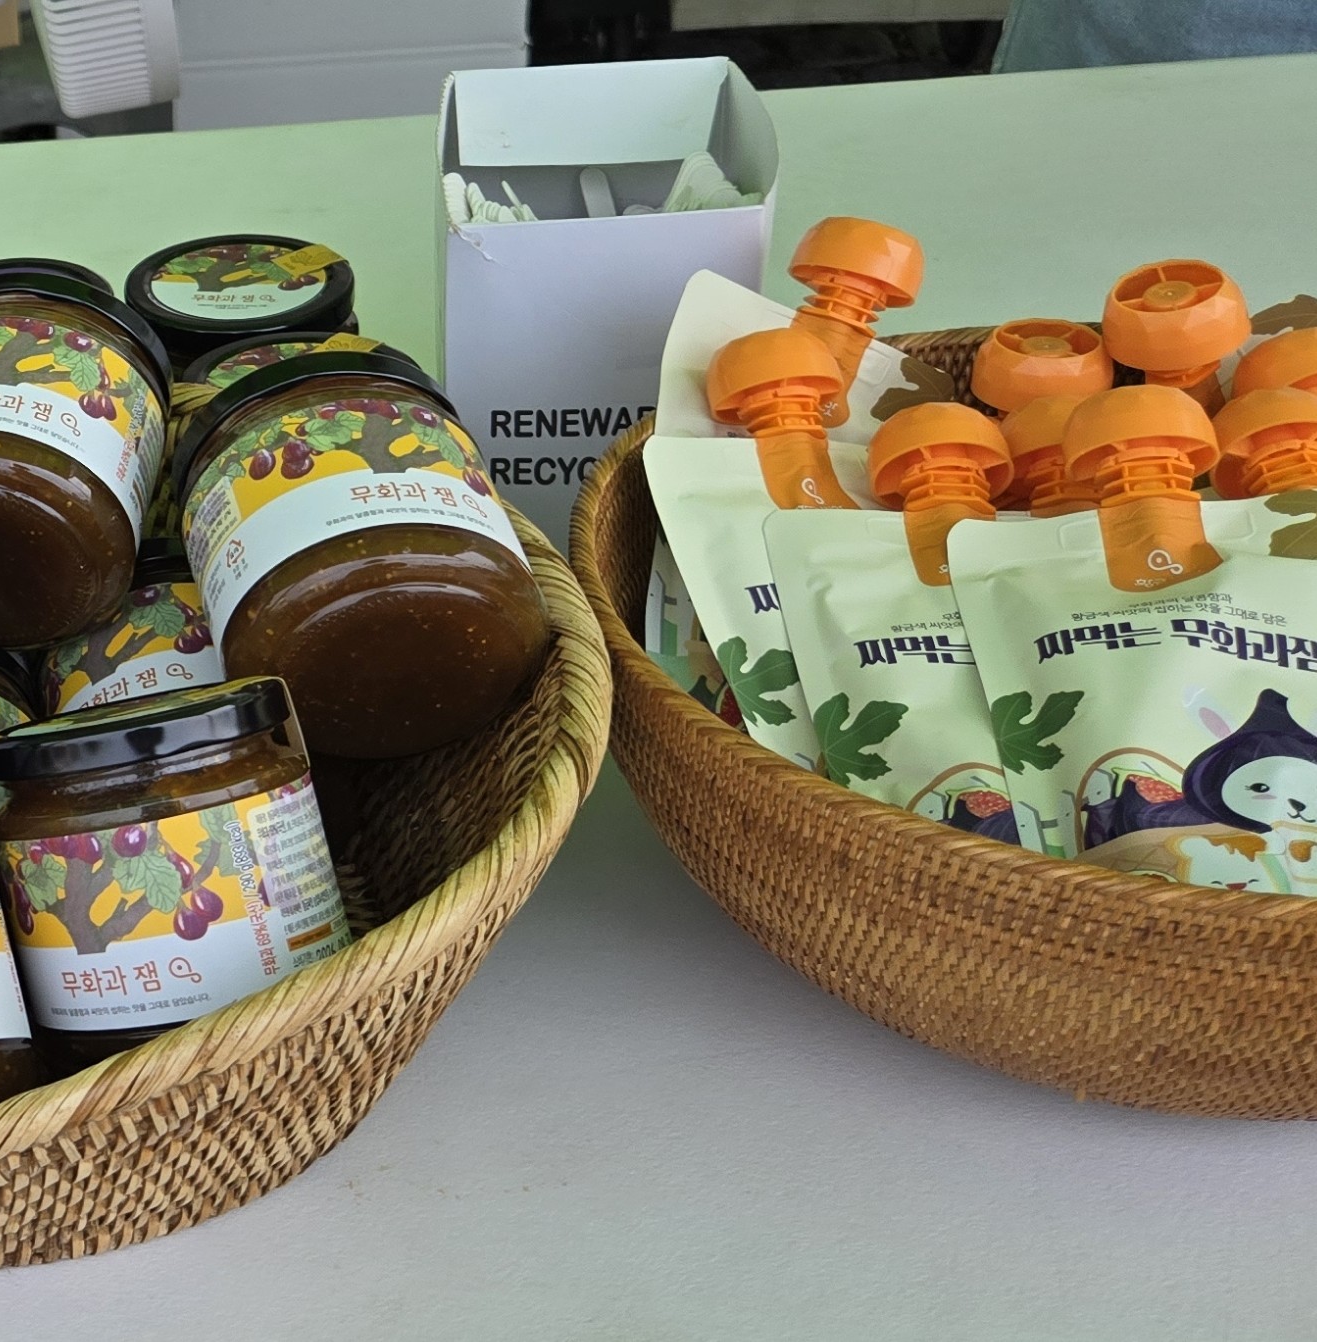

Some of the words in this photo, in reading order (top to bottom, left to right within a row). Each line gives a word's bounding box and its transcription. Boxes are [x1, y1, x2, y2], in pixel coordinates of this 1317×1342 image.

[31, 400, 54, 422] 잼
[491, 406, 656, 438] RENEWA
[350, 481, 427, 503] 무화과
[431, 485, 458, 507] 잼
[890, 621, 928, 633] 황금색
[1071, 610, 1110, 622] 황금색
[1113, 606, 1152, 618] 씨앗의
[1155, 604, 1193, 617] 씹히는
[1223, 606, 1259, 621] 그대로
[1261, 613, 1288, 627] 담은
[1034, 621, 1162, 665] 짜먹는
[80, 677, 129, 709] 화과
[135, 667, 157, 689] 잼
[223, 821, 242, 845] kcal)
[240, 873, 256, 893] 290
[259, 949, 280, 976] 무화과
[61, 965, 127, 998] 무화과
[133, 960, 161, 993] 잼
[132, 1003, 147, 1012] 맛을
[148, 999, 170, 1010] 그대로
[171, 992, 212, 1008] 담았습니다.
